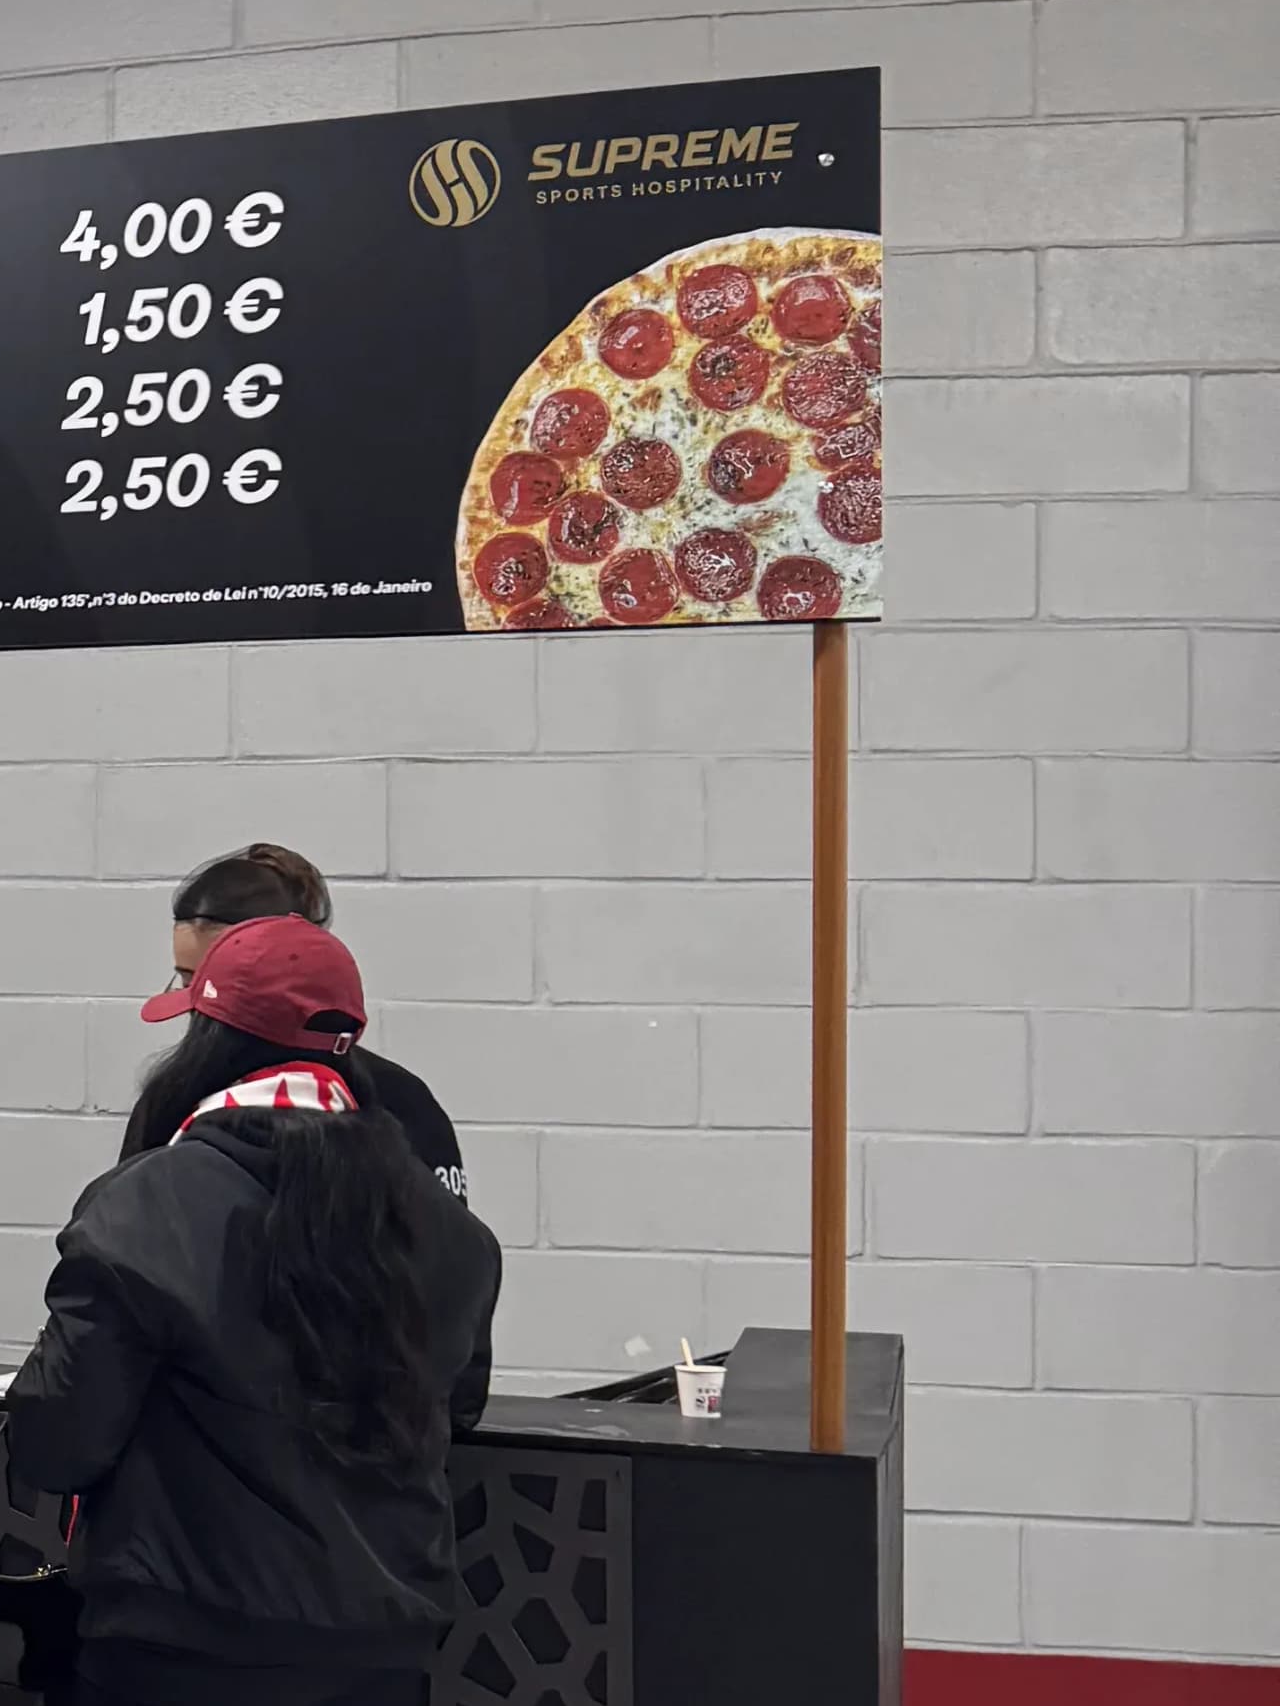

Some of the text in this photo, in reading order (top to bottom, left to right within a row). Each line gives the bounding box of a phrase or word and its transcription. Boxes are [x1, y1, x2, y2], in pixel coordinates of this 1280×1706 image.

[528, 122, 800, 182] SUPREME
[536, 170, 783, 205] SPORTS HOSPITALITY
[59, 191, 285, 270] 4,00 €
[79, 277, 284, 354] 1,50 €
[60, 363, 283, 438] 2,50 €
[60, 448, 283, 521] 2,50 €
[12, 597, 58, 612] Artigo
[117, 593, 138, 605] do
[139, 591, 200, 604] Decreto
[202, 589, 222, 601] de
[223, 587, 247, 600] Lei
[330, 583, 349, 595] 16
[350, 582, 370, 594] de
[372, 580, 433, 593] Janeiro
